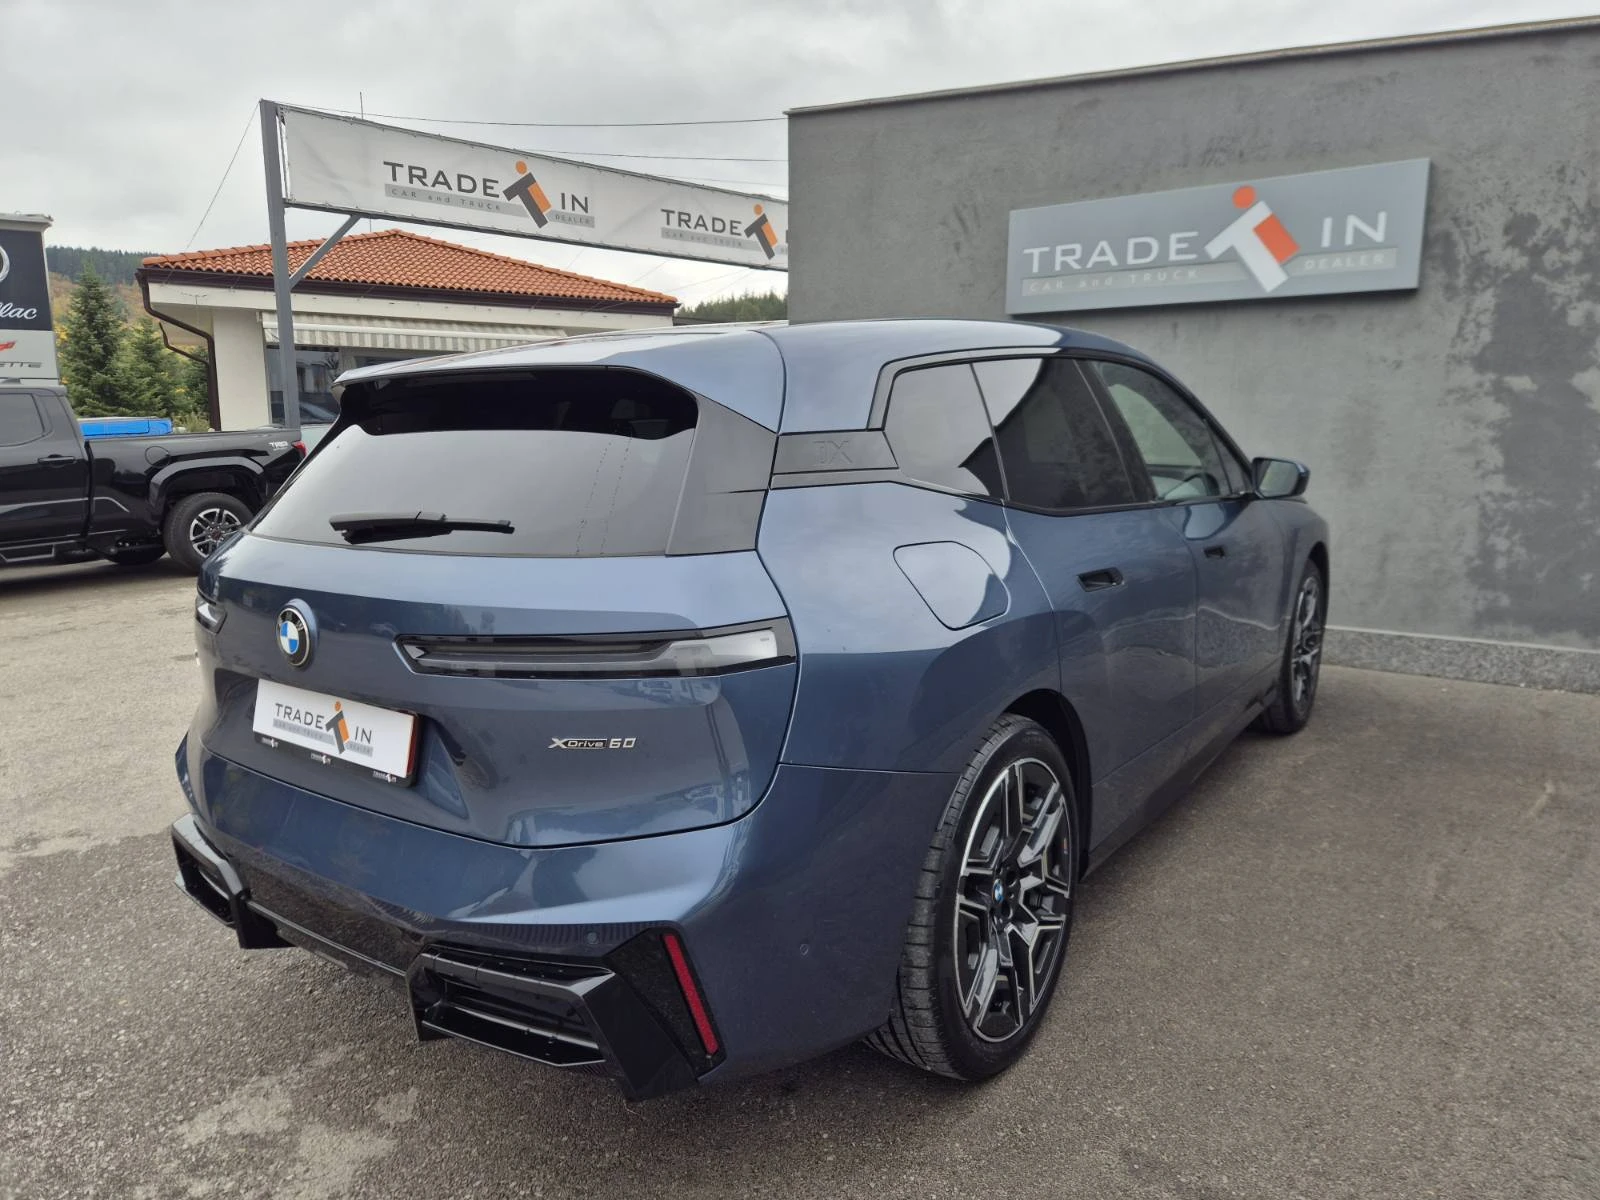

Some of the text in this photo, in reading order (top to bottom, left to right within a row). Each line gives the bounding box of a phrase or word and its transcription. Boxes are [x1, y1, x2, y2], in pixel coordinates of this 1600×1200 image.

[383, 161, 500, 198] TRADE
[560, 192, 589, 214] IN
[391, 187, 417, 199] CAR
[661, 208, 742, 236] TRADE
[1023, 231, 1199, 273] TRADE
[1321, 211, 1387, 248] IN
[1030, 281, 1063, 293] CAR
[1130, 268, 1199, 284] TRUCK
[1304, 253, 1385, 271] DEALER
[0, 302, 37, 320] lac
[275, 703, 325, 730] TRADE
[355, 725, 373, 744] IN
